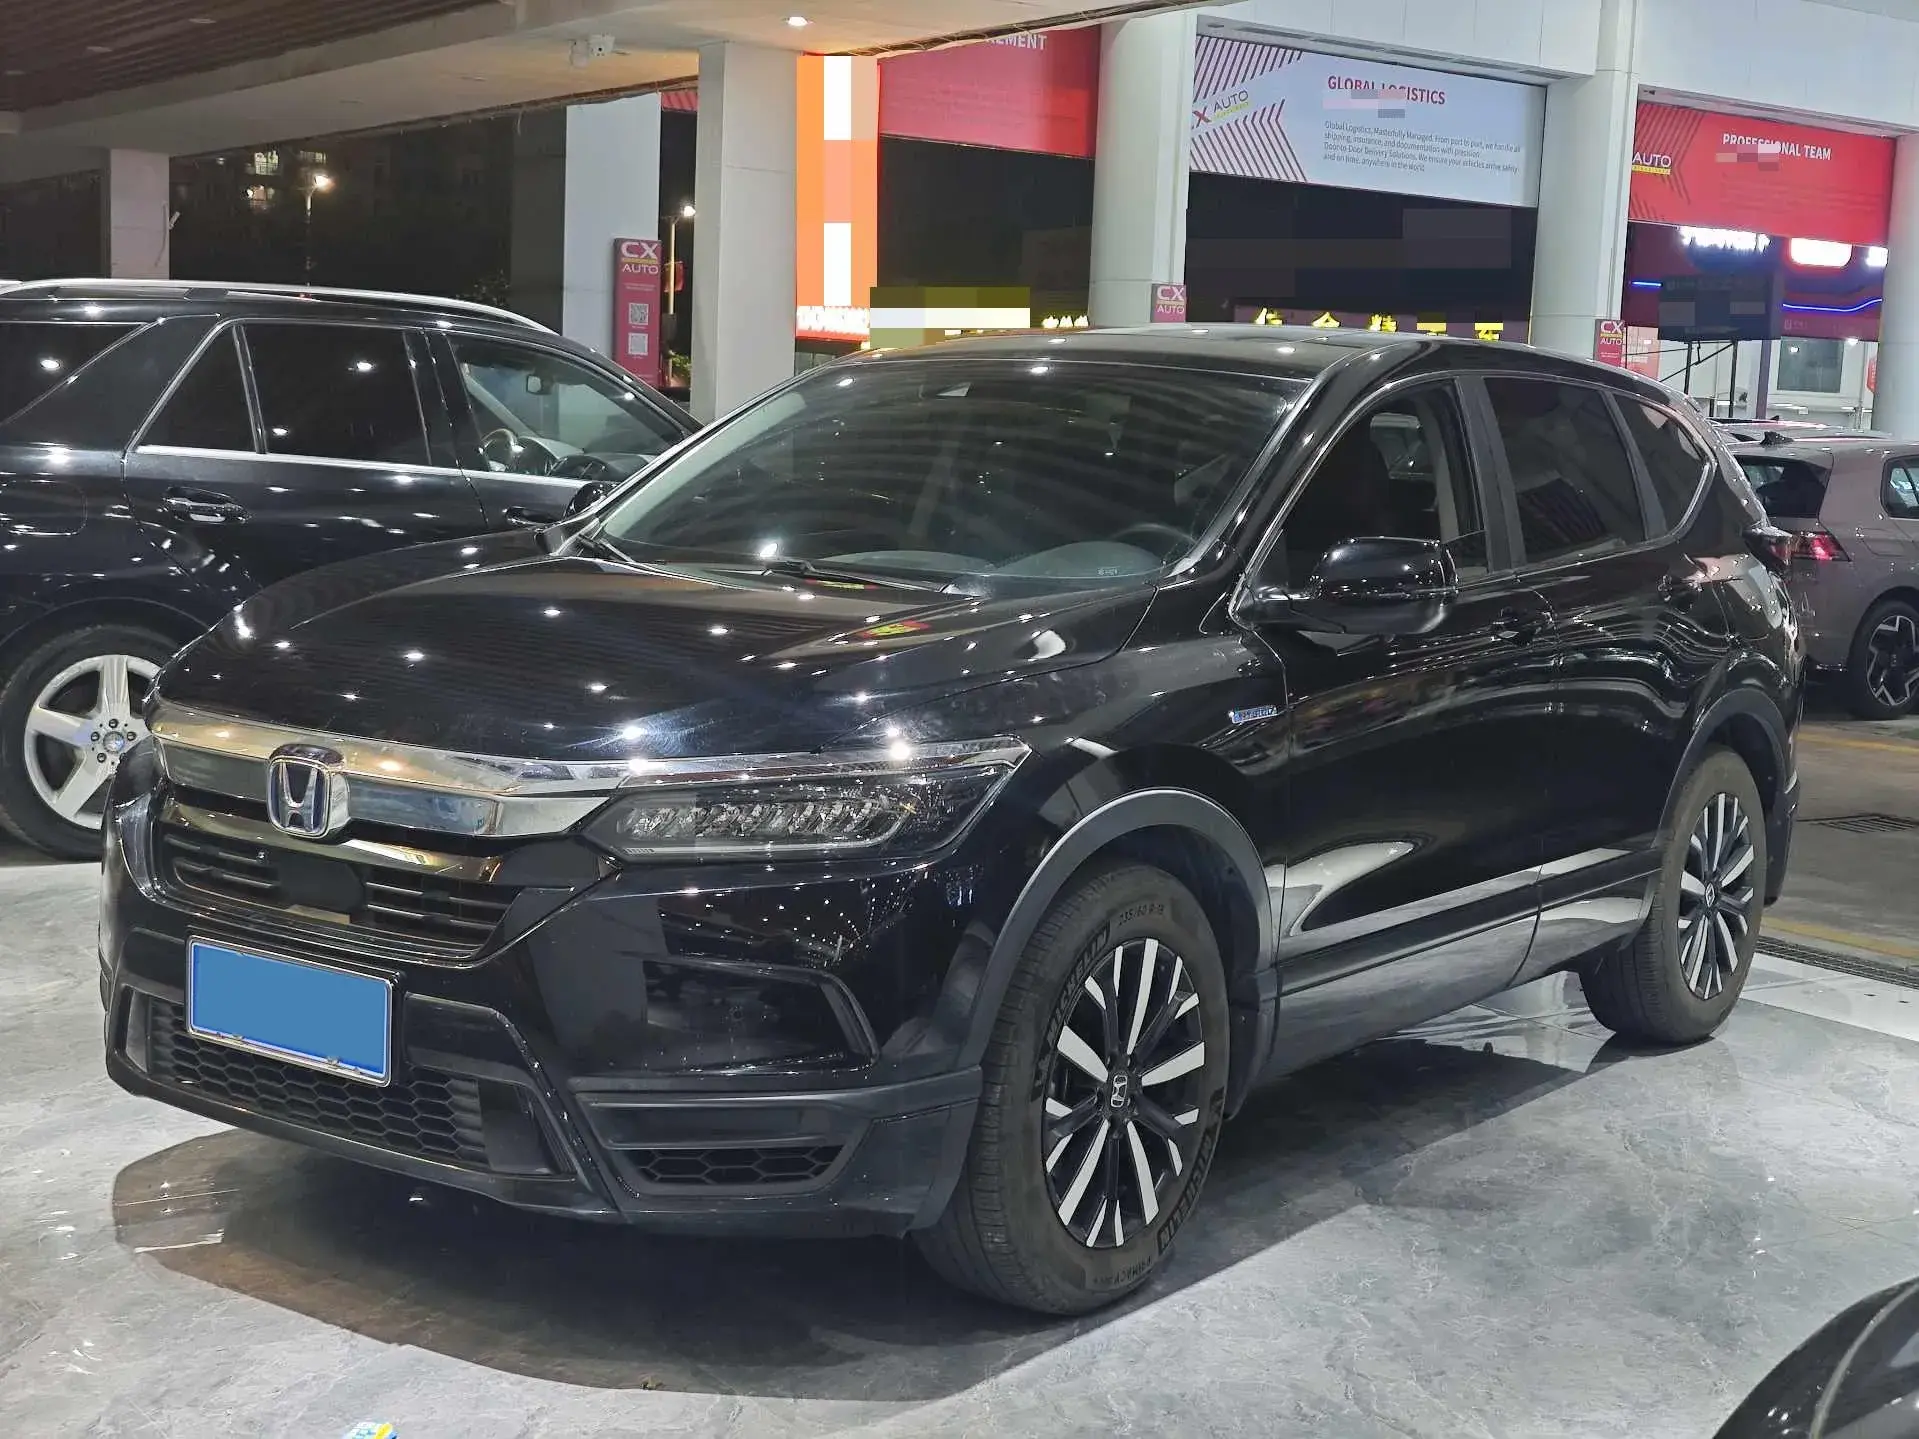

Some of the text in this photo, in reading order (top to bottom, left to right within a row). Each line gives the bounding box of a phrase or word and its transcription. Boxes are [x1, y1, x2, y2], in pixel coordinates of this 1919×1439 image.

[1214, 89, 1249, 113] AUTO
[1382, 83, 1446, 105] ISTICS
[1723, 133, 1832, 161] PROFENAL TEAM
[1632, 152, 1672, 168] AUTO
[621, 241, 658, 259] CX
[622, 263, 659, 275] AUTO
[1157, 285, 1185, 301] CX
[1157, 304, 1185, 314] AUTO
[1600, 320, 1625, 334] CX
[1600, 338, 1622, 346] AUTO
